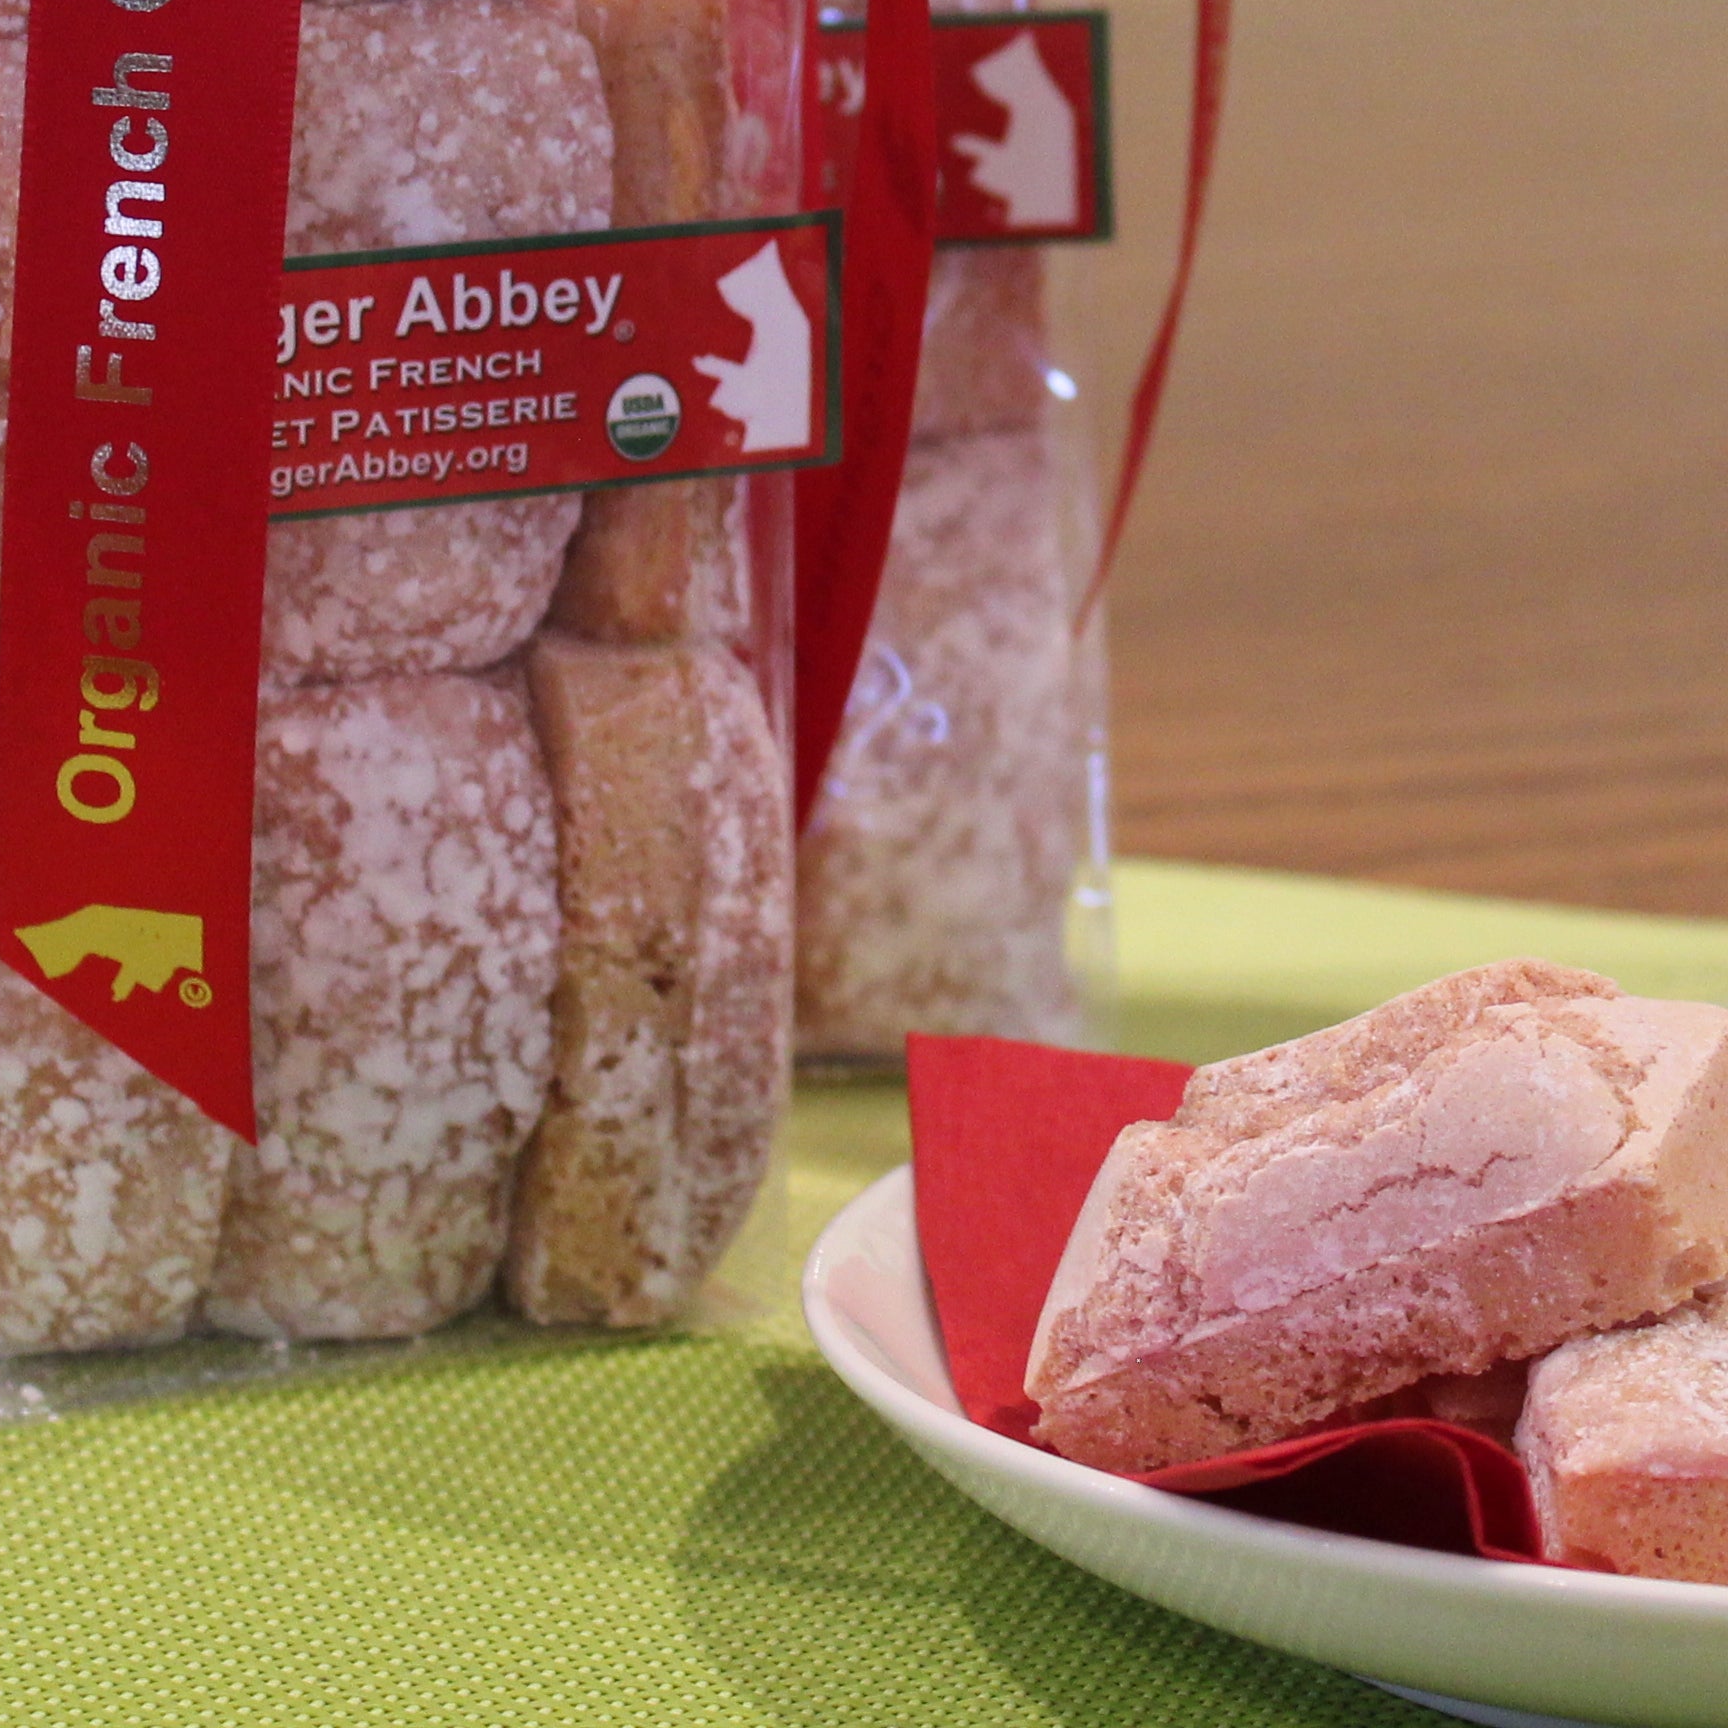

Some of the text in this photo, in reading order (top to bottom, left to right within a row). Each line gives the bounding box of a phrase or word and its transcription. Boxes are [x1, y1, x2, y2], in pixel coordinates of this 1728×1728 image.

[75, 52, 172, 405] French
[273, 349, 542, 401] NIC FRENCH
[330, 391, 579, 444] PATISSERIE
[56, 441, 160, 823] Organic
